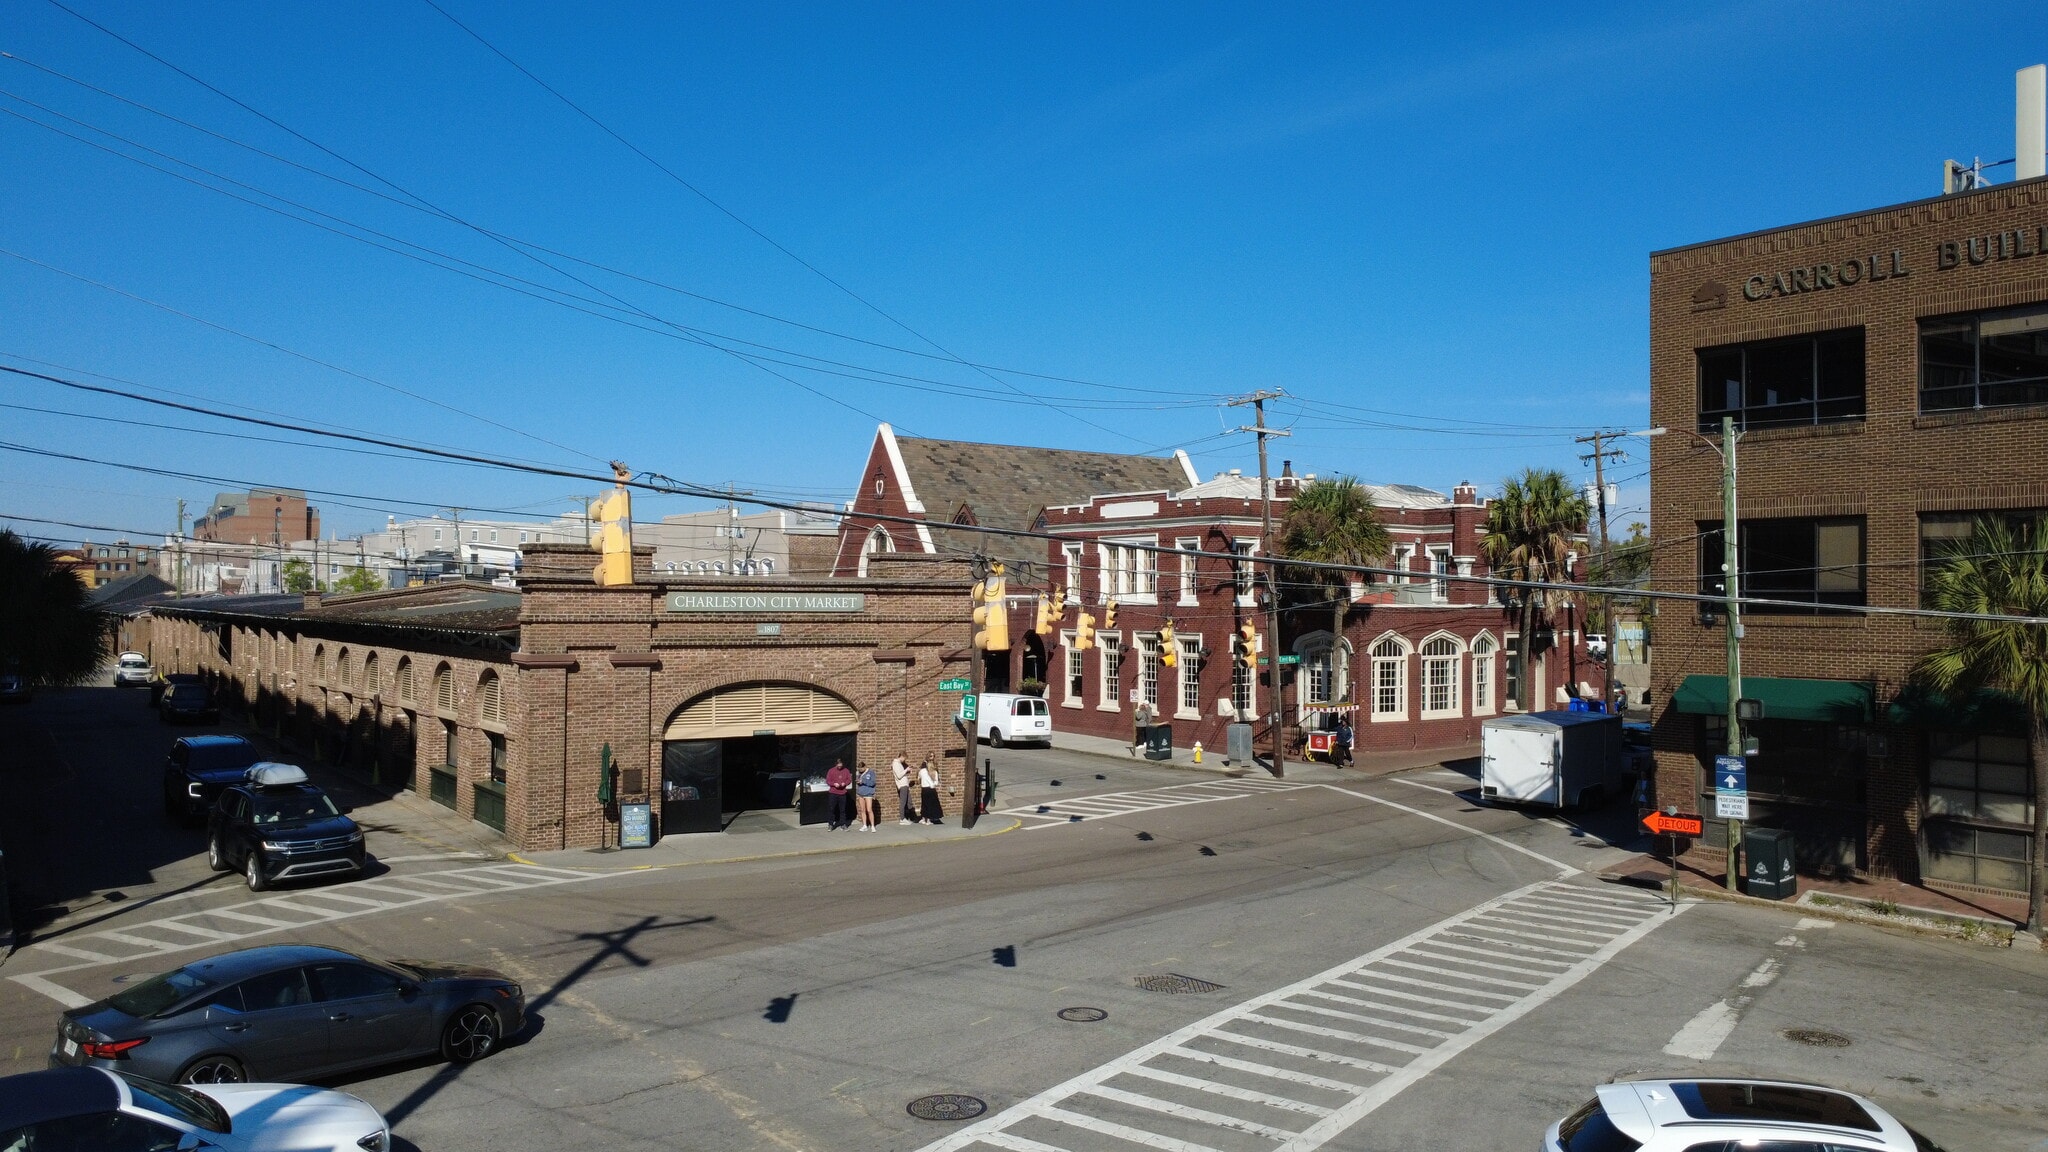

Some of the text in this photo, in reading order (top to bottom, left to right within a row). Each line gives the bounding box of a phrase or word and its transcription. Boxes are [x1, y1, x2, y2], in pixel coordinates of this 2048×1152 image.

[1743, 250, 1910, 300] CARROLL
[674, 595, 858, 609] CHARLESTON CITY MARKET
[764, 625, 779, 634] 1807
[939, 681, 953, 690] East
[953, 681, 964, 691] Bay
[1657, 818, 1697, 831] DETOUR
